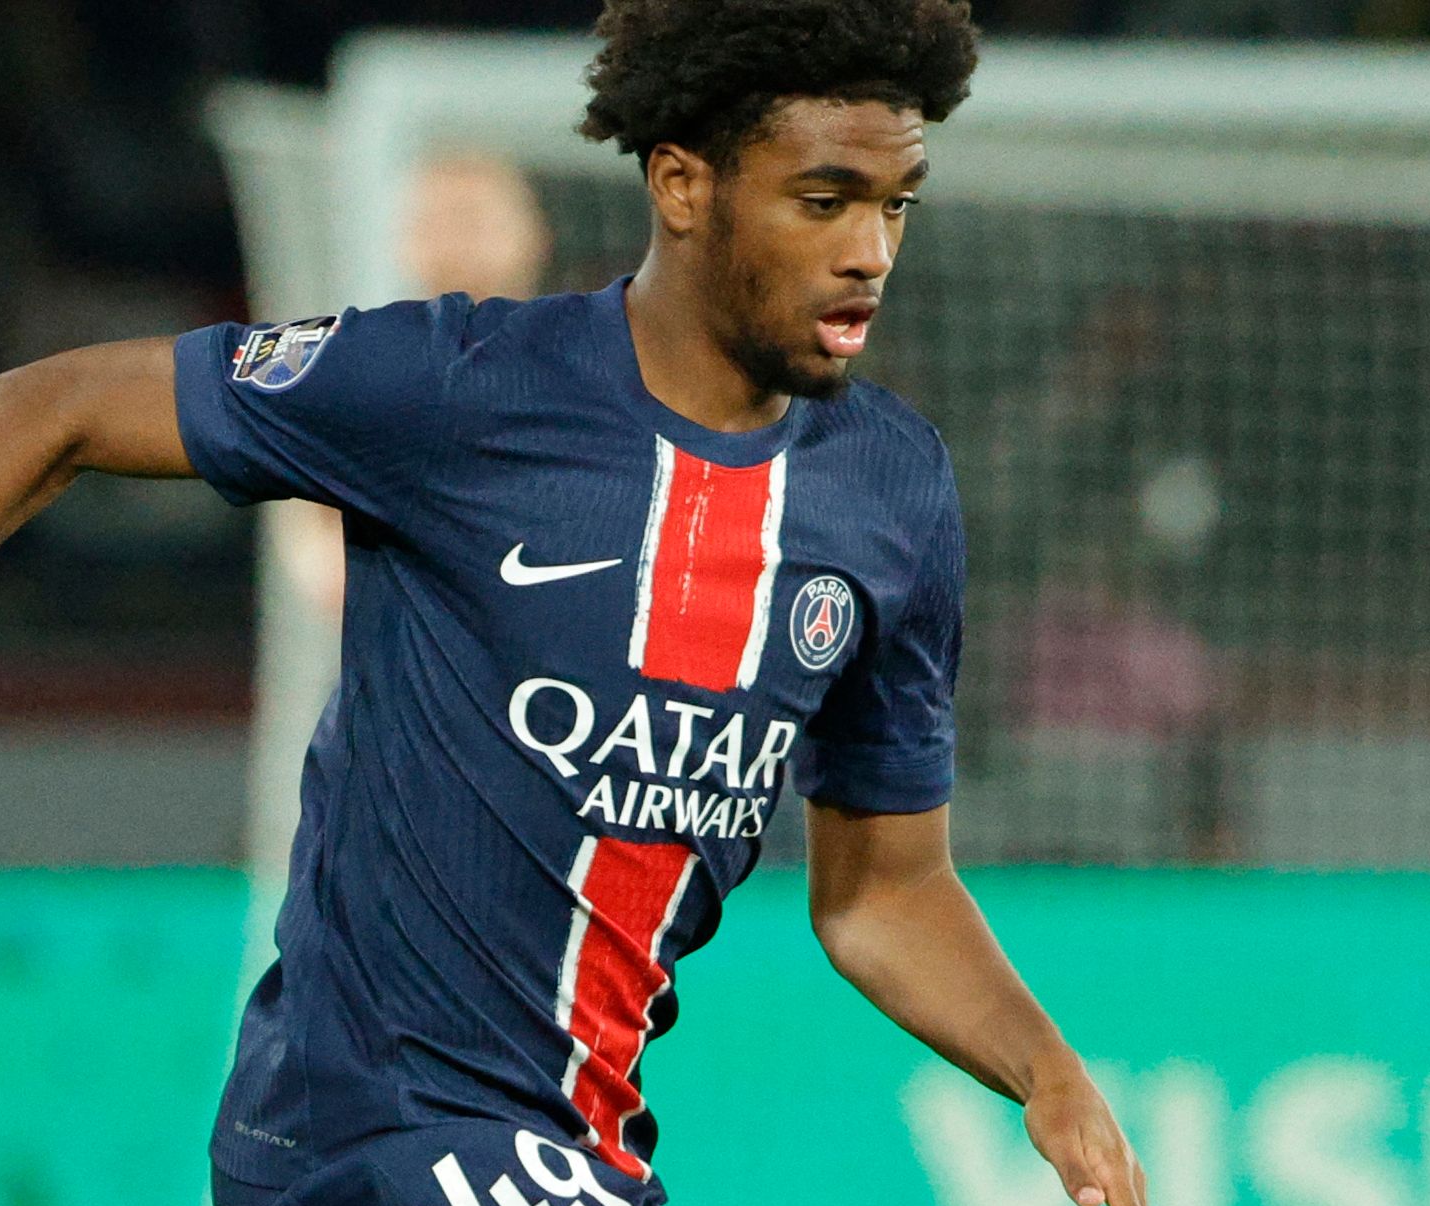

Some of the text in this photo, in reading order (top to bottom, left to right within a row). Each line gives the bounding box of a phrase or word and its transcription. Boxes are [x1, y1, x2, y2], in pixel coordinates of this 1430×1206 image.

[806, 580, 850, 607] PARIS
[508, 677, 796, 789] QATAR
[576, 774, 768, 839] AIRWAYS
